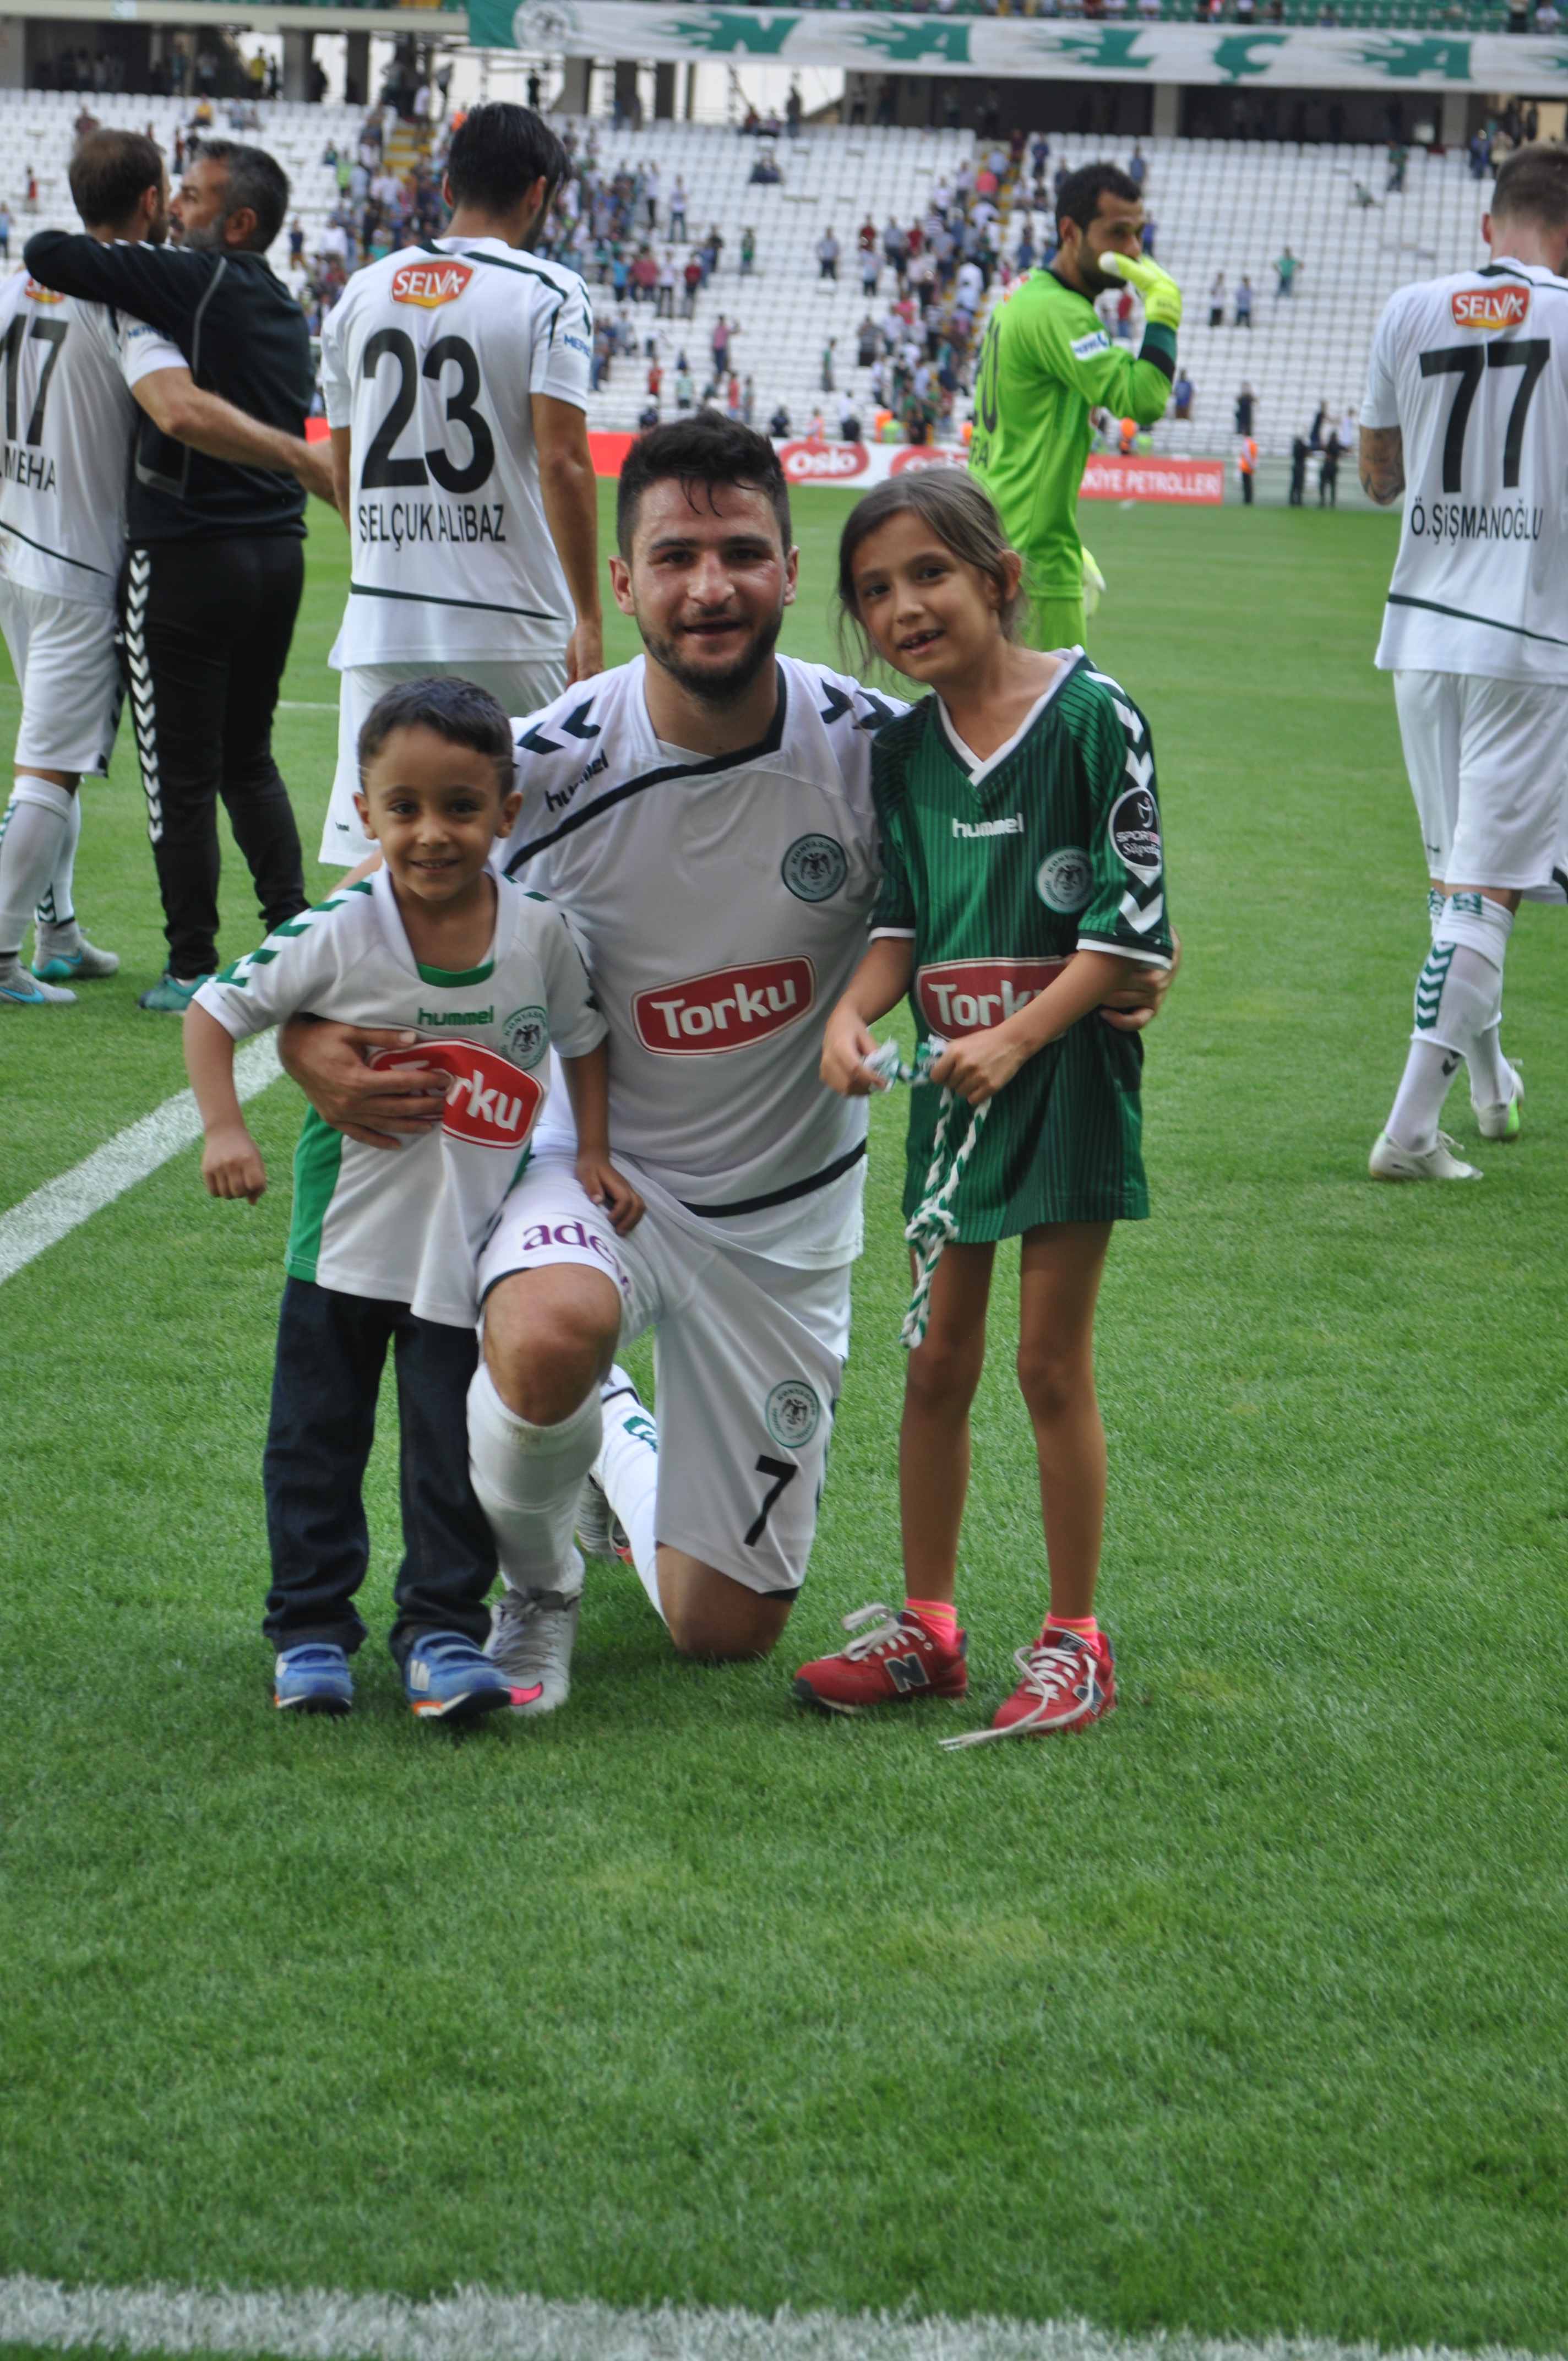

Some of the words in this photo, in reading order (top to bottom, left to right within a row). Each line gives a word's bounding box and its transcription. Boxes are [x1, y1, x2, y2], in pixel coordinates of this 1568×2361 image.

[394, 270, 465, 298] SELVA
[1455, 292, 1524, 320] SELVA
[361, 328, 494, 494] 23
[1420, 338, 1550, 493] 77
[359, 503, 433, 551] SELÇUK
[952, 813, 1024, 837] hummel
[417, 1005, 495, 1026] hummel
[650, 978, 796, 1039] Torku
[928, 980, 1044, 1027] Tork
[744, 1454, 798, 1547] 7
